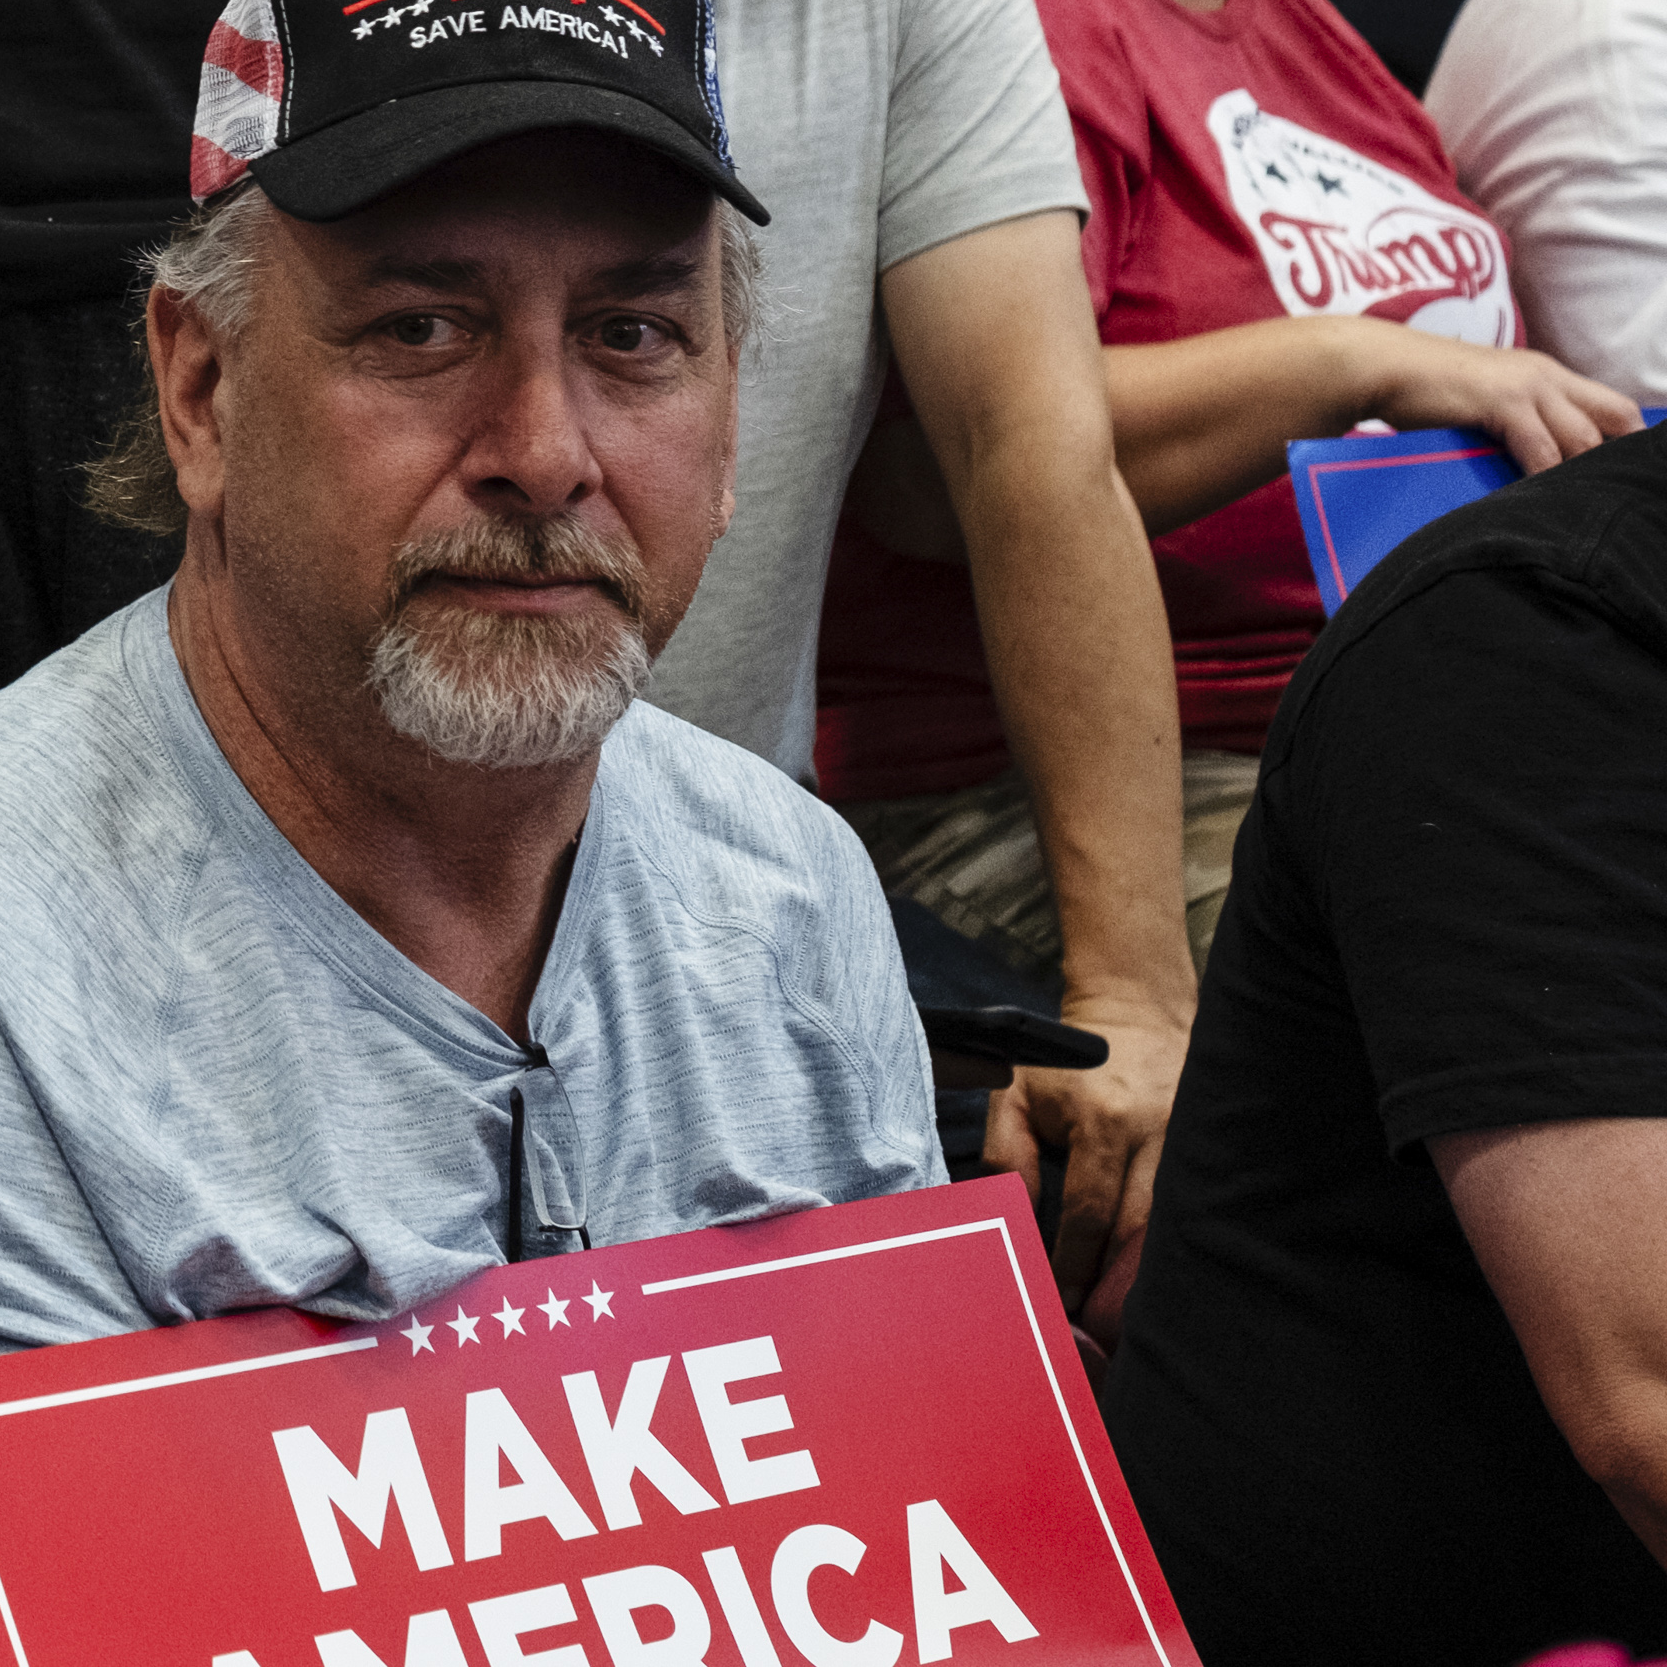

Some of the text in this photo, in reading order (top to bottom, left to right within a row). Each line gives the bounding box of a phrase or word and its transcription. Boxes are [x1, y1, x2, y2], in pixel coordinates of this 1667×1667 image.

[410, 5, 629, 59] SAVE AMERICA!
[1259, 210, 1495, 309] Trump
[271, 1335, 821, 1593] MAKE
